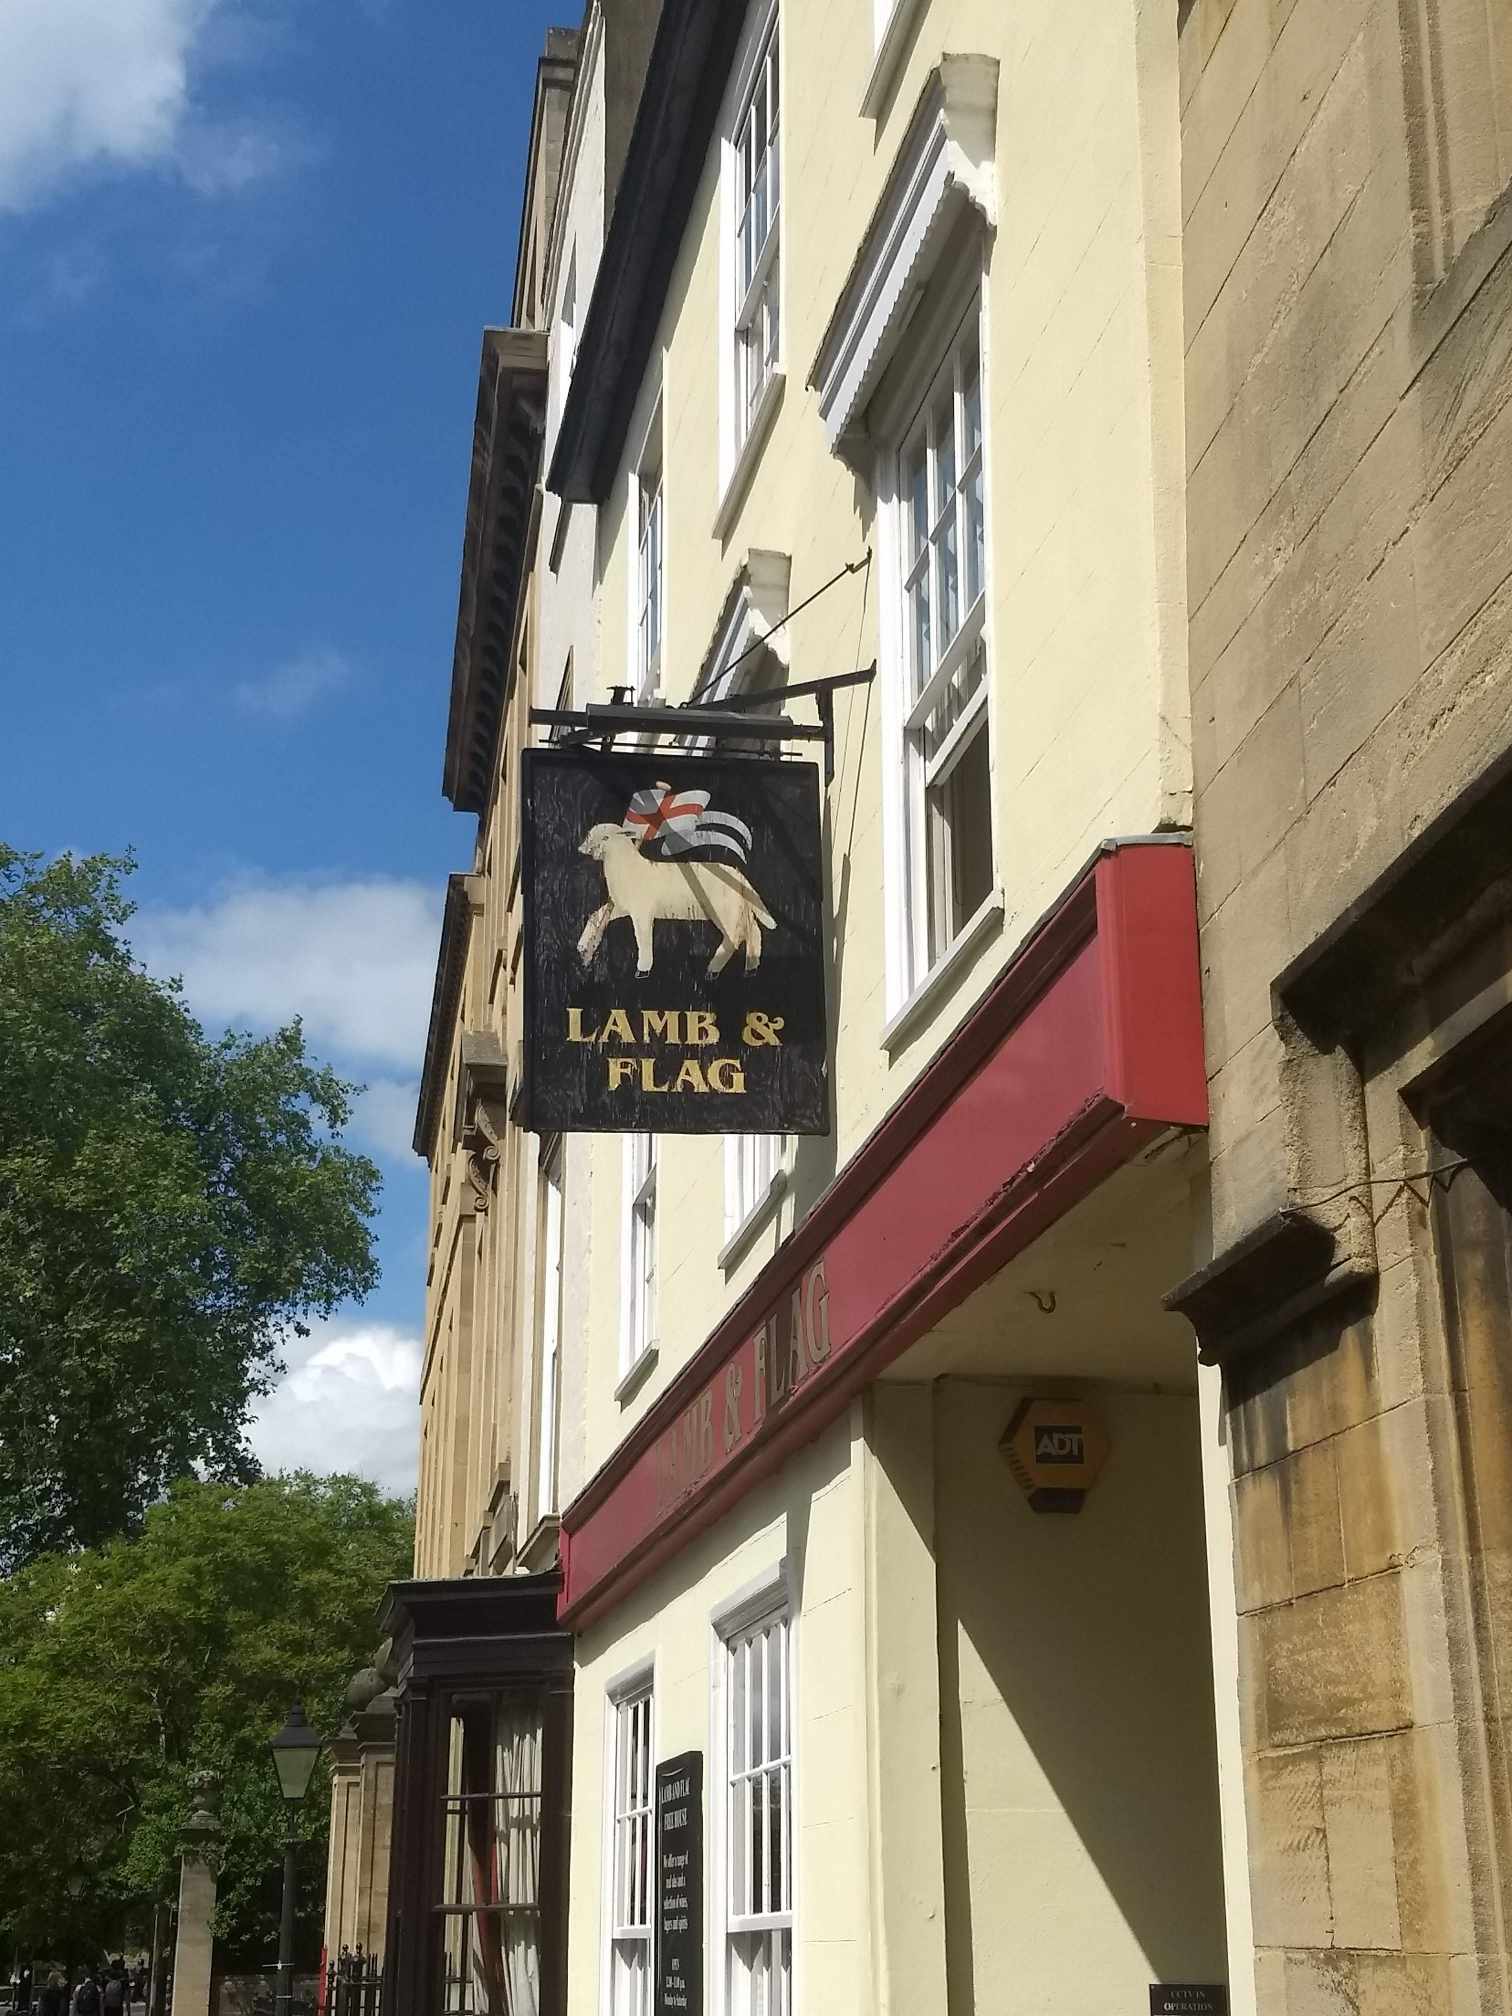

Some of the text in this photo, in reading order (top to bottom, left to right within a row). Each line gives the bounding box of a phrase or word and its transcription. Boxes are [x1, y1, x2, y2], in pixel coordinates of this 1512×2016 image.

[566, 1007, 786, 1047] LAMB &
[607, 1057, 747, 1094] FLAG
[1037, 1431, 1084, 1456] ADT
[1163, 2001, 1214, 2012] OPERATION
